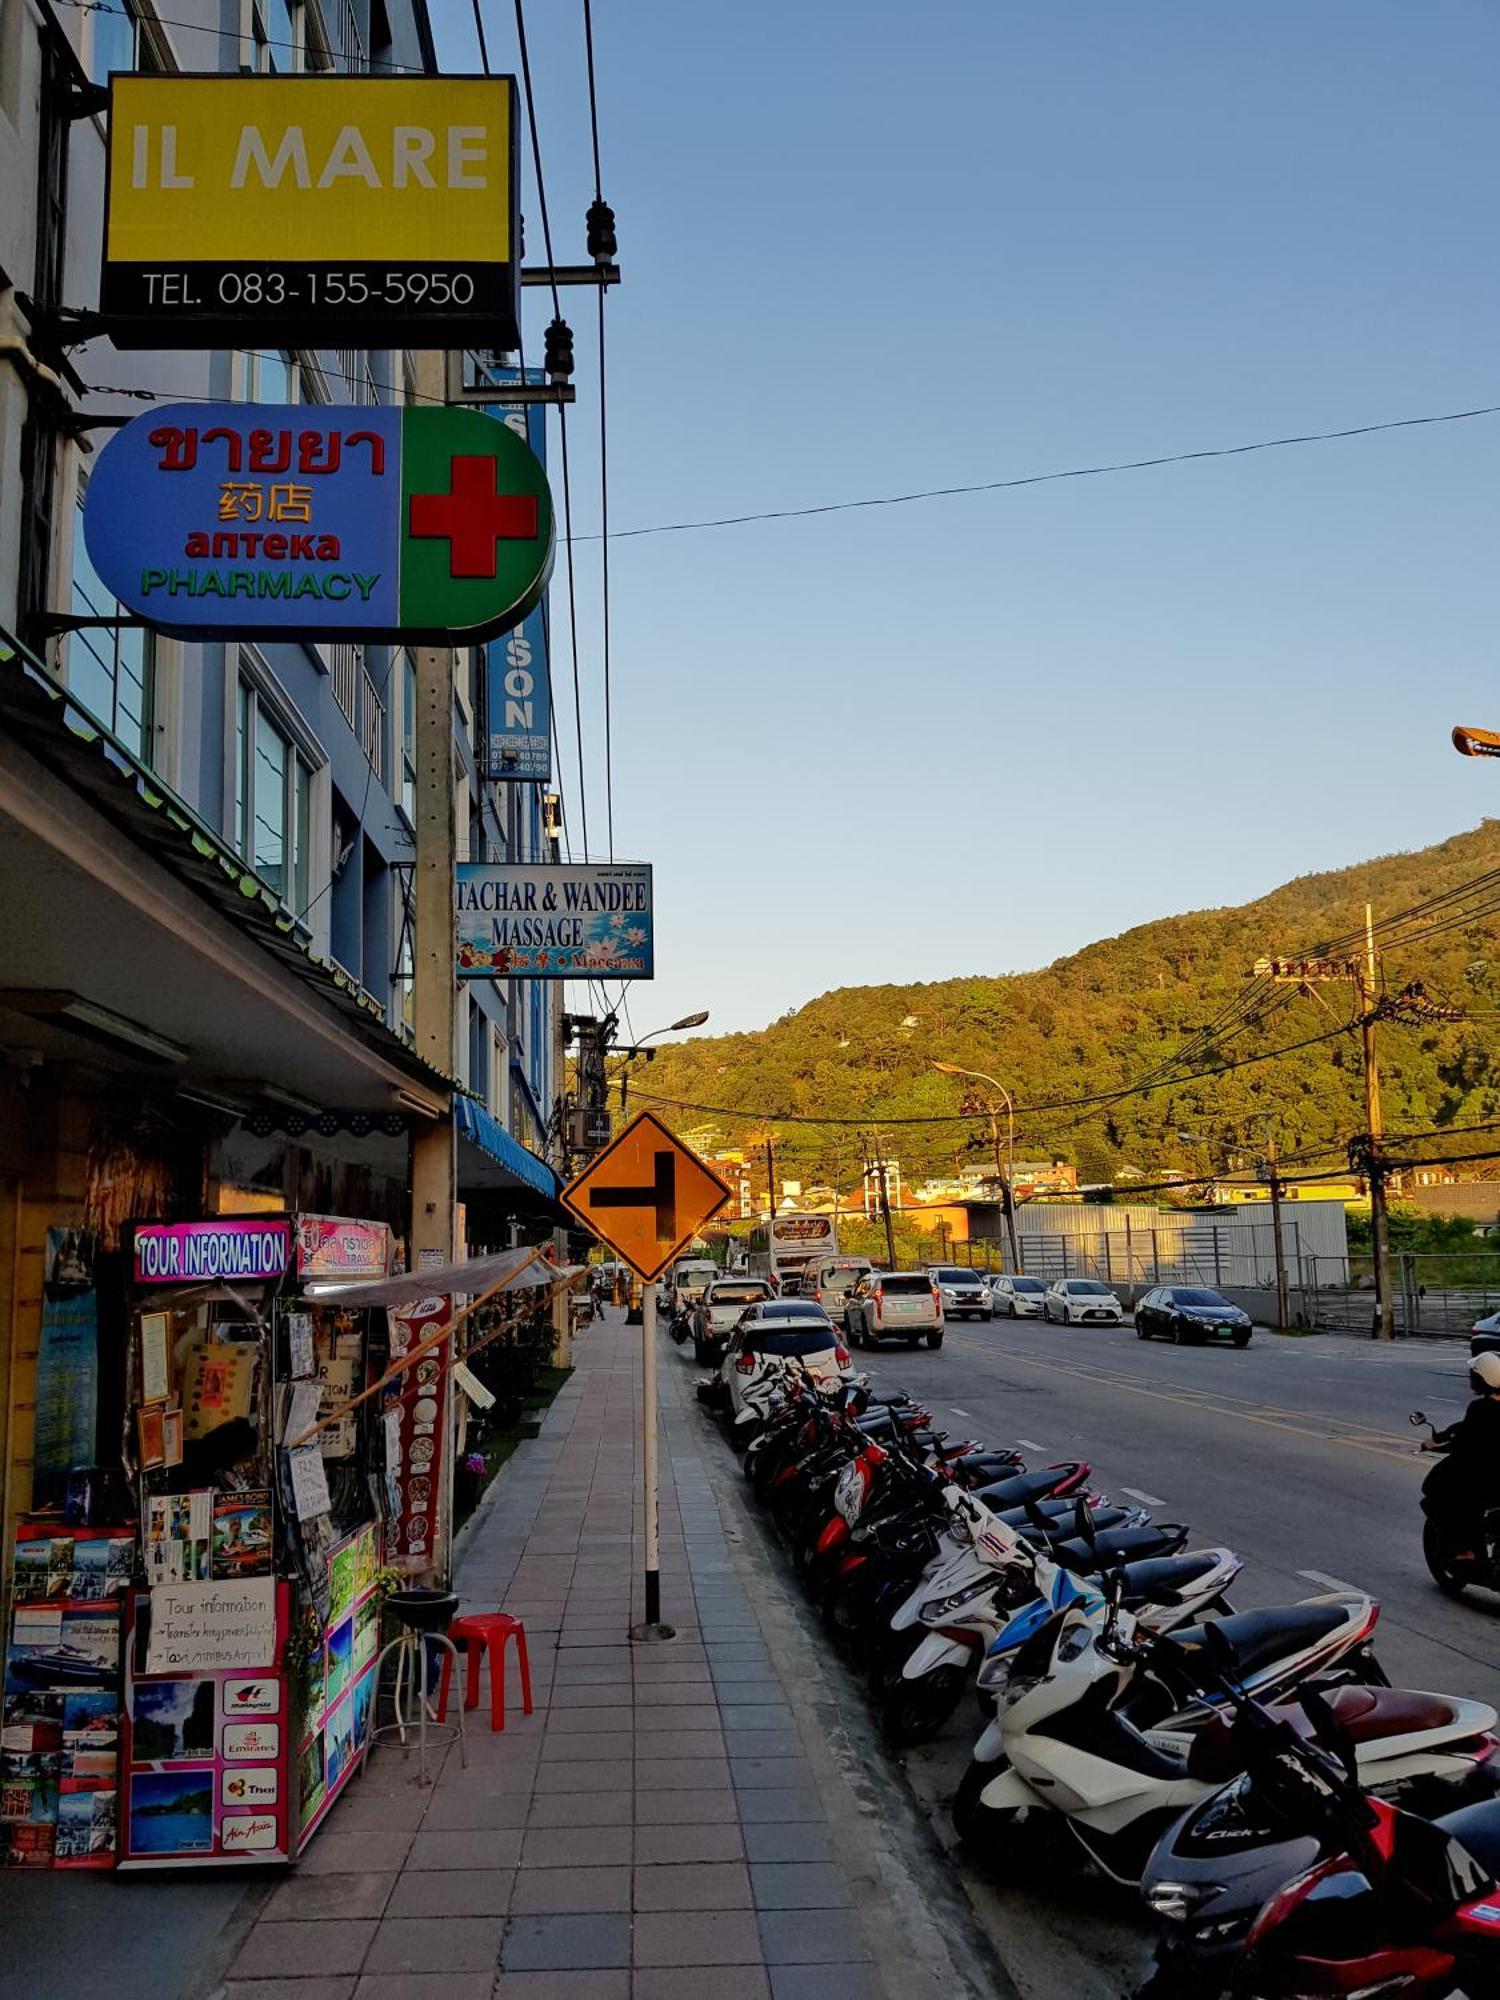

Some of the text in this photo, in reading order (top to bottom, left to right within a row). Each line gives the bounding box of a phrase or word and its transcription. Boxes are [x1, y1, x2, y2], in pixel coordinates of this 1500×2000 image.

[132, 124, 488, 190] IL MARE
[142, 271, 475, 305] TEL. 083-155-5950
[149, 426, 386, 475] ขายยา
[217, 481, 314, 523] 药店
[184, 531, 341, 561] аптека
[140, 567, 382, 600] PHARMACY
[542, 881, 558, 911] &
[563, 881, 647, 911] WANDEE
[491, 916, 584, 947] MASSAGE
[138, 1231, 286, 1276] TOUR INFORMATION
[165, 1593, 266, 1615] Tour information
[228, 1745, 276, 1754] Emirates
